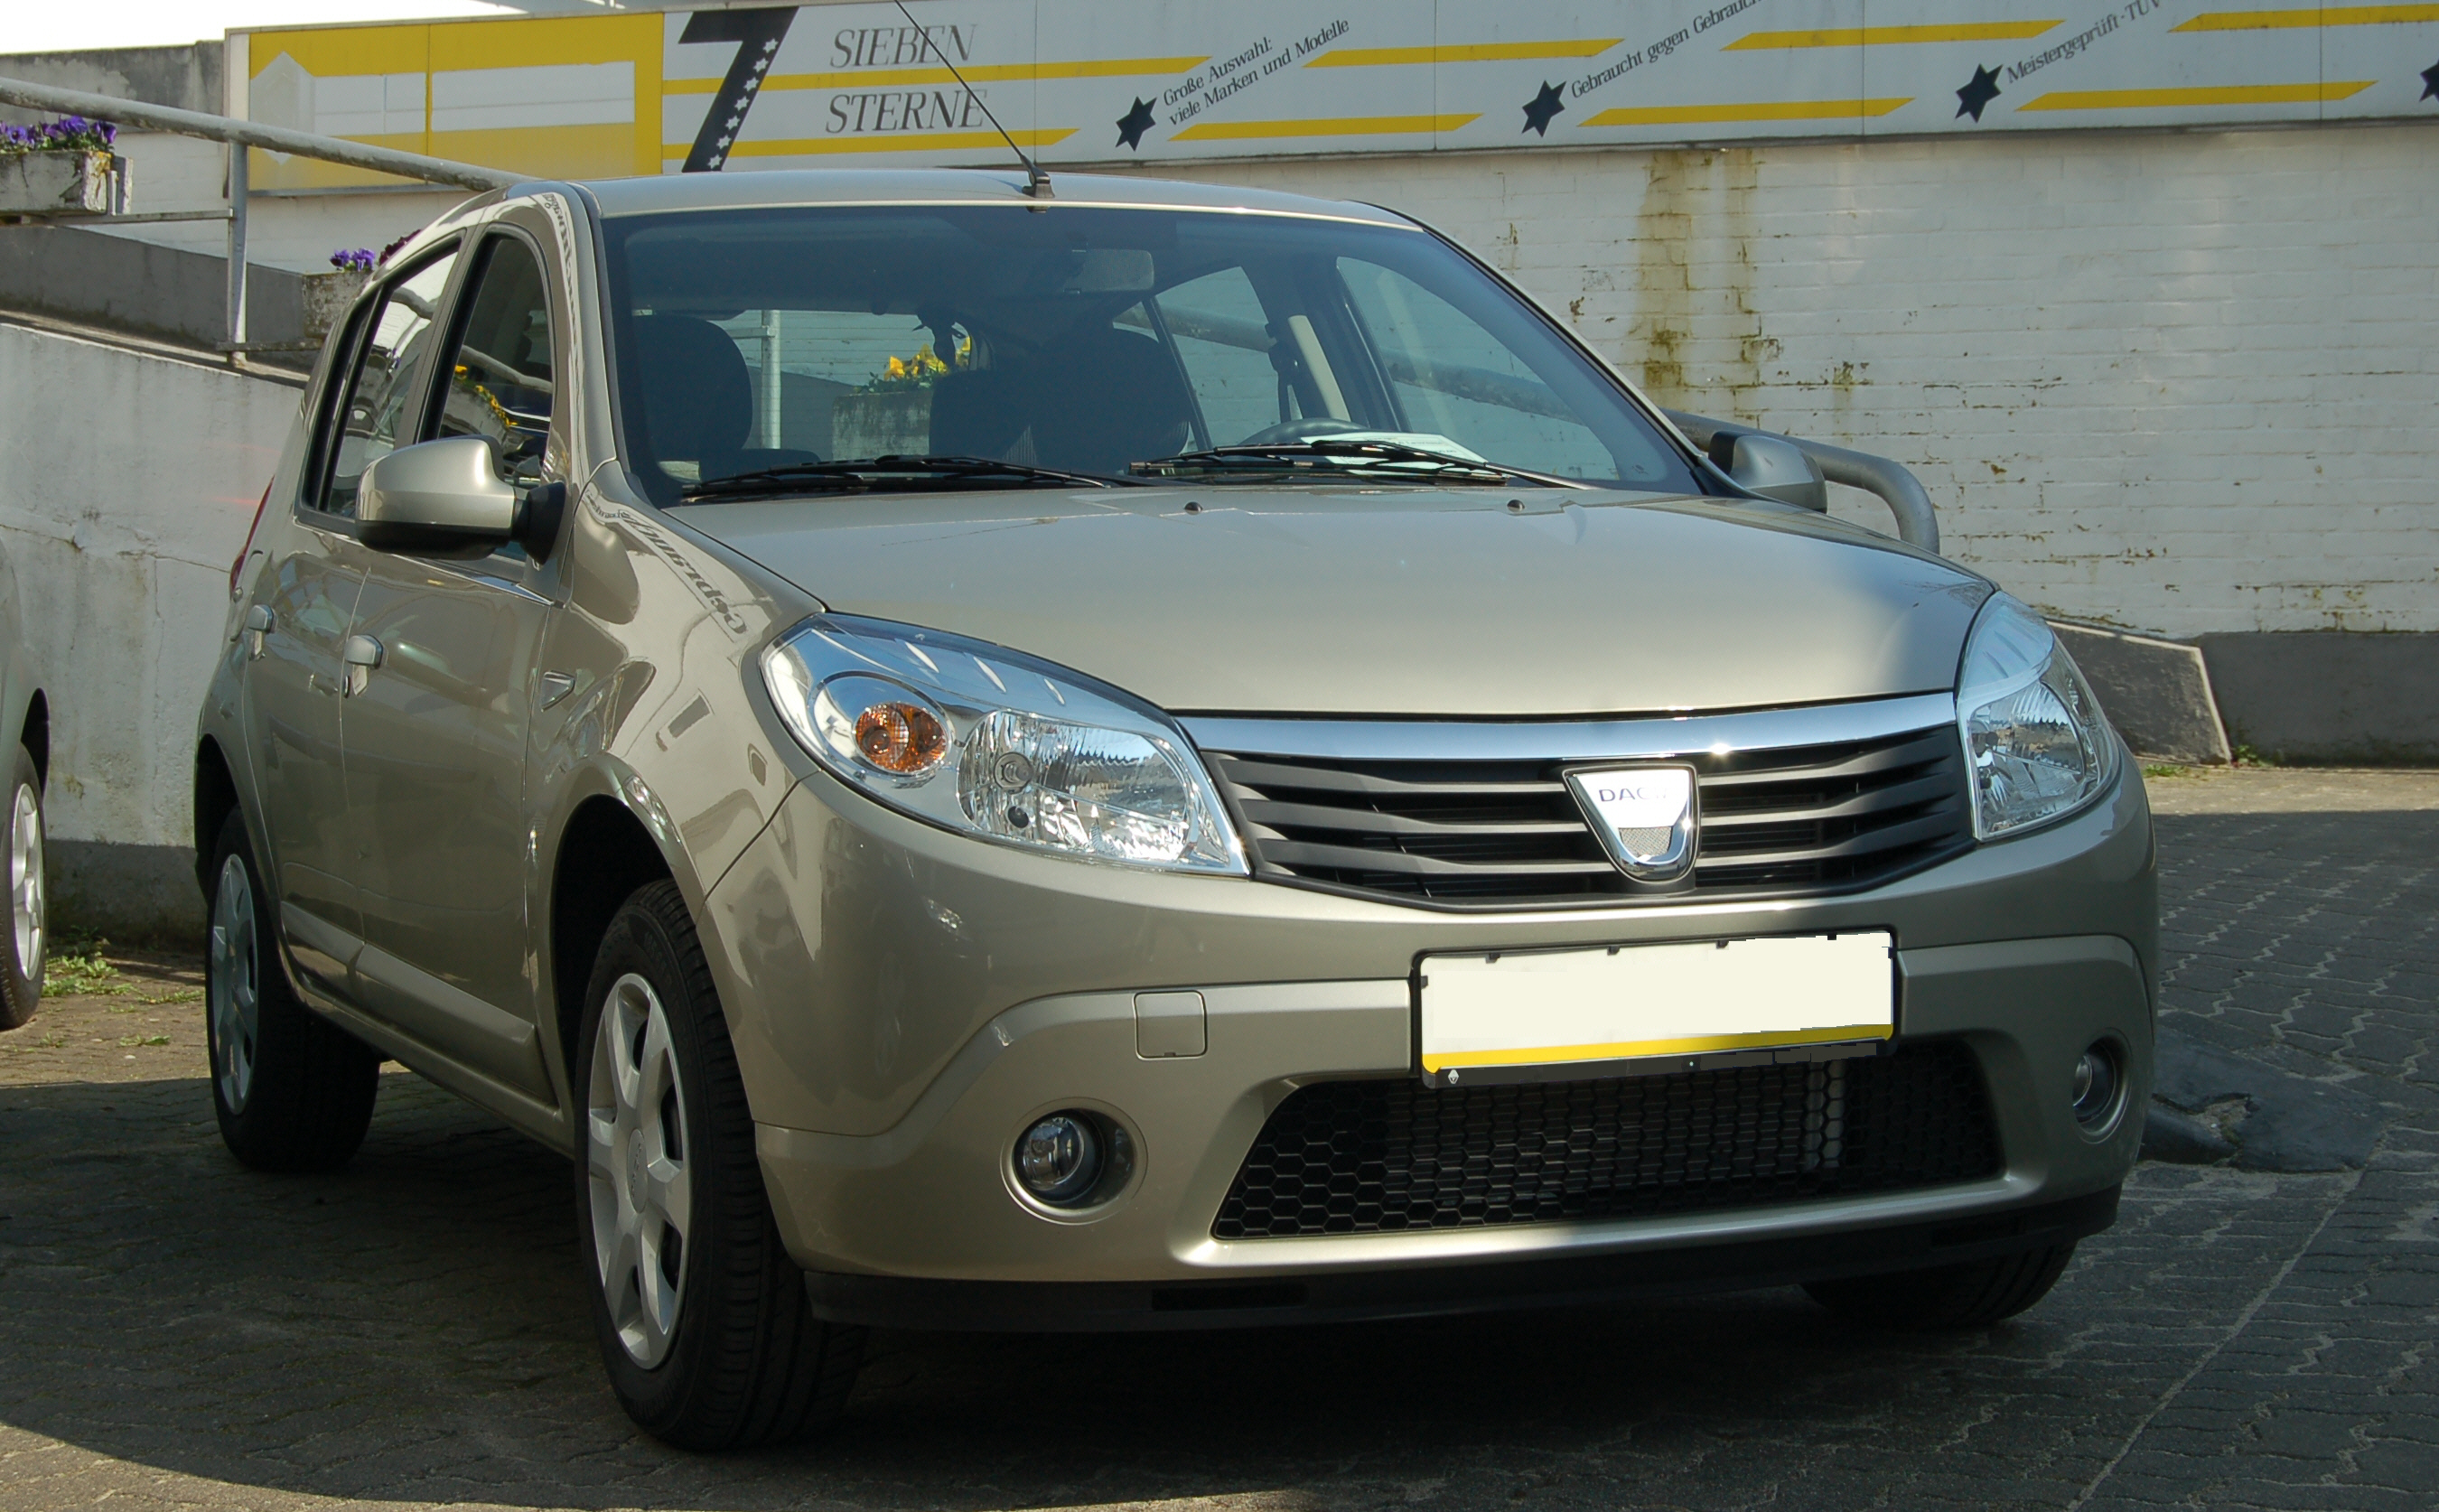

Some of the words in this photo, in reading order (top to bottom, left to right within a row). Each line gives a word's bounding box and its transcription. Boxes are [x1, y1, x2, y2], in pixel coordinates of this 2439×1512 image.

[829, 23, 978, 69] SIEBEN
[1163, 76, 1204, 107] Große
[1209, 37, 1273, 83] Auswahl:
[1169, 99, 1201, 126] viele
[1203, 70, 1258, 107] Marken
[1262, 48, 1292, 76] und
[1294, 19, 1350, 58] Modelle
[1571, 54, 1643, 98] Gebraucht
[1647, 28, 1690, 63] gegen
[678, 6, 799, 173] 7
[825, 89, 987, 134] STERNE
